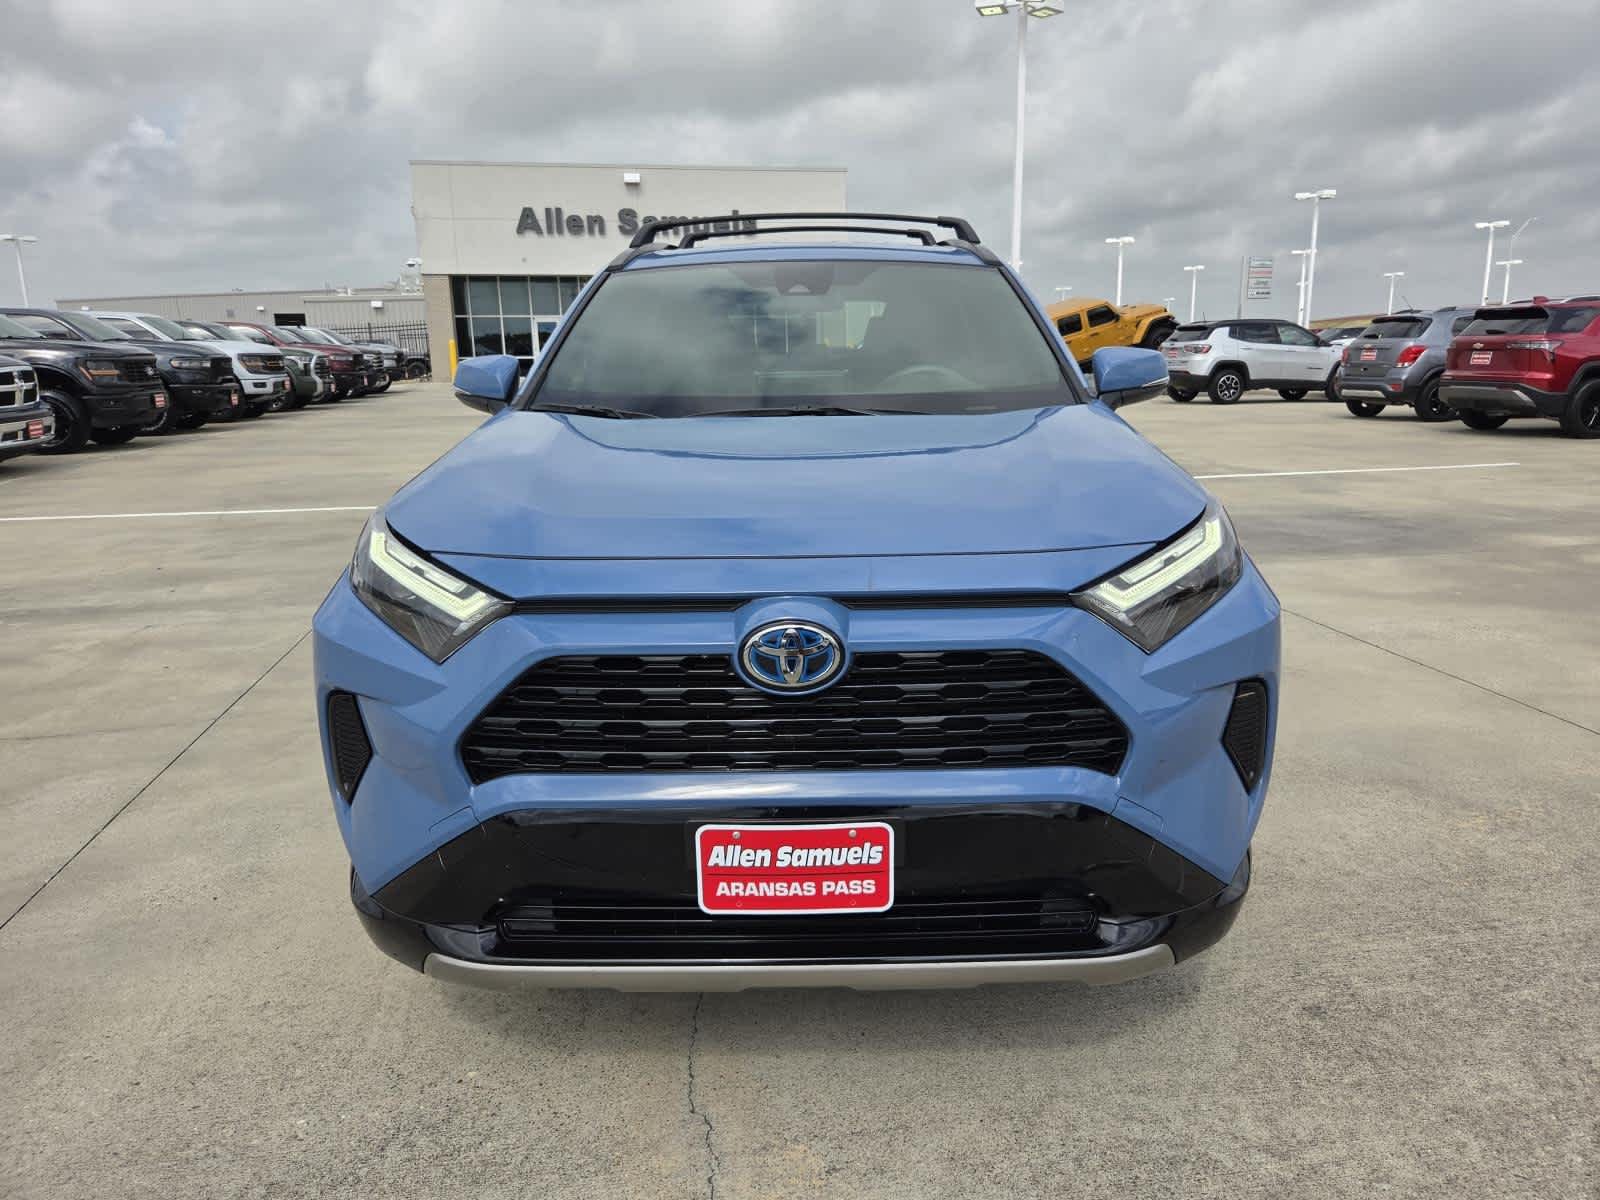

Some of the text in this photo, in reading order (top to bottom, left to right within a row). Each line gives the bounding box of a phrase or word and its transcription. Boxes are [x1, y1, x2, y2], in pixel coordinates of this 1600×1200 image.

[515, 206, 606, 236] Allen
[707, 842, 884, 867] Allen Samuels
[716, 879, 876, 897] ARANSAS PASS
